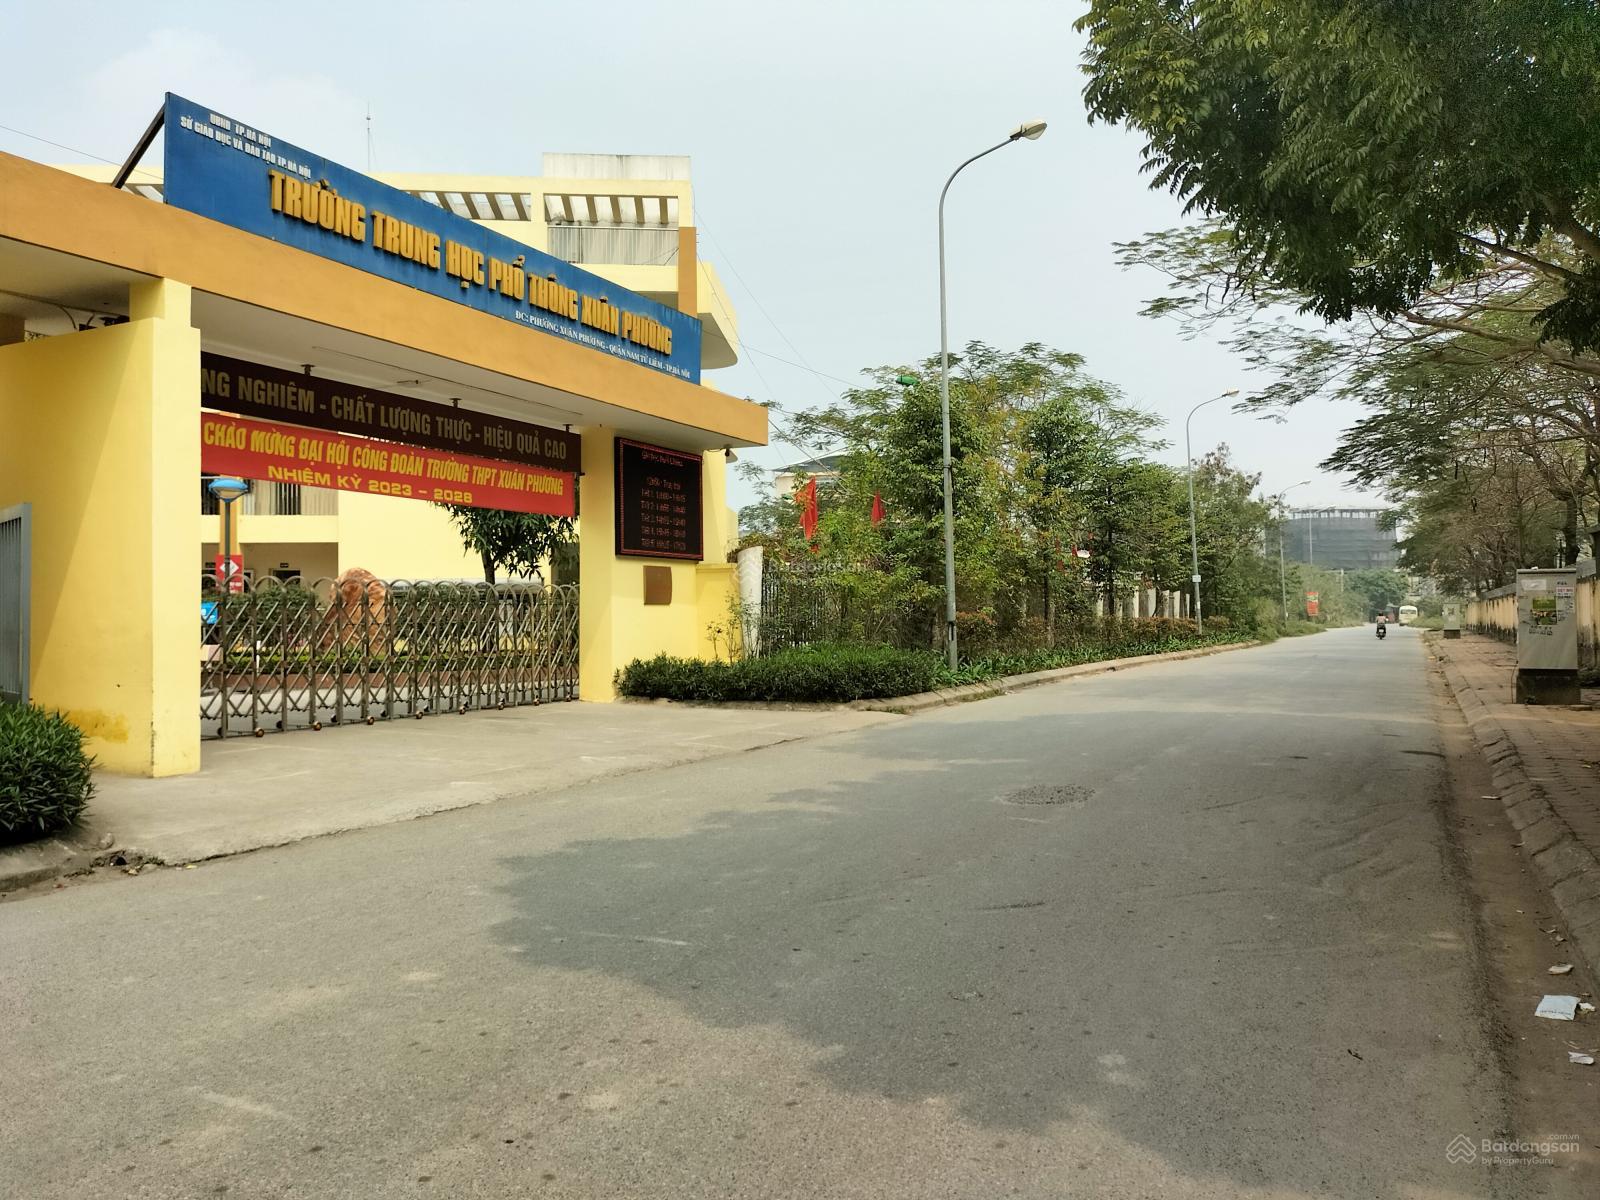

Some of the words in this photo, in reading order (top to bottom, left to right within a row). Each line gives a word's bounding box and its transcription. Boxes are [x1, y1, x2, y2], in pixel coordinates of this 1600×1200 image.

[180, 115, 193, 130] SỞ
[194, 121, 214, 139] GIÁO
[215, 130, 231, 146] DỤC
[232, 137, 244, 151] VÀ
[262, 149, 276, 165] TẠO
[269, 169, 366, 242] TRƯỜNG
[372, 211, 441, 270] TRUNG
[445, 239, 485, 290] HỌC
[487, 254, 526, 301] PHỔ
[528, 272, 579, 321] THÔNG
[580, 295, 620, 337] XUÂN
[621, 309, 673, 357] PHƯƠNG
[529, 314, 560, 333] PHƯỜNG
[559, 325, 579, 340] XUÂN
[578, 332, 606, 350] PHƯƠNG
[626, 349, 641, 363] NAM
[648, 357, 664, 370] LIÊM
[237, 375, 315, 414] NGHIÊM
[331, 393, 375, 425] CHẤT
[379, 405, 431, 437] LƯỢNG
[435, 415, 472, 445] THỰC
[483, 424, 513, 453] HIỆU
[516, 430, 540, 456] QUẢ
[544, 438, 567, 460] CAO
[203, 421, 247, 450] CHÀO
[250, 427, 296, 458] MỪNG
[298, 437, 323, 466] ĐẠI
[325, 440, 350, 470] HỘI
[390, 451, 424, 478] ĐOÀN
[426, 456, 471, 485] TRƯỜNG
[472, 464, 498, 487] THPT
[497, 468, 526, 492] XUÂN
[526, 474, 564, 497] PHƯƠNG
[268, 465, 331, 486] NHIỆM
[337, 472, 363, 491] KỲ
[368, 480, 413, 497] 2023
[433, 488, 474, 504] 2028
